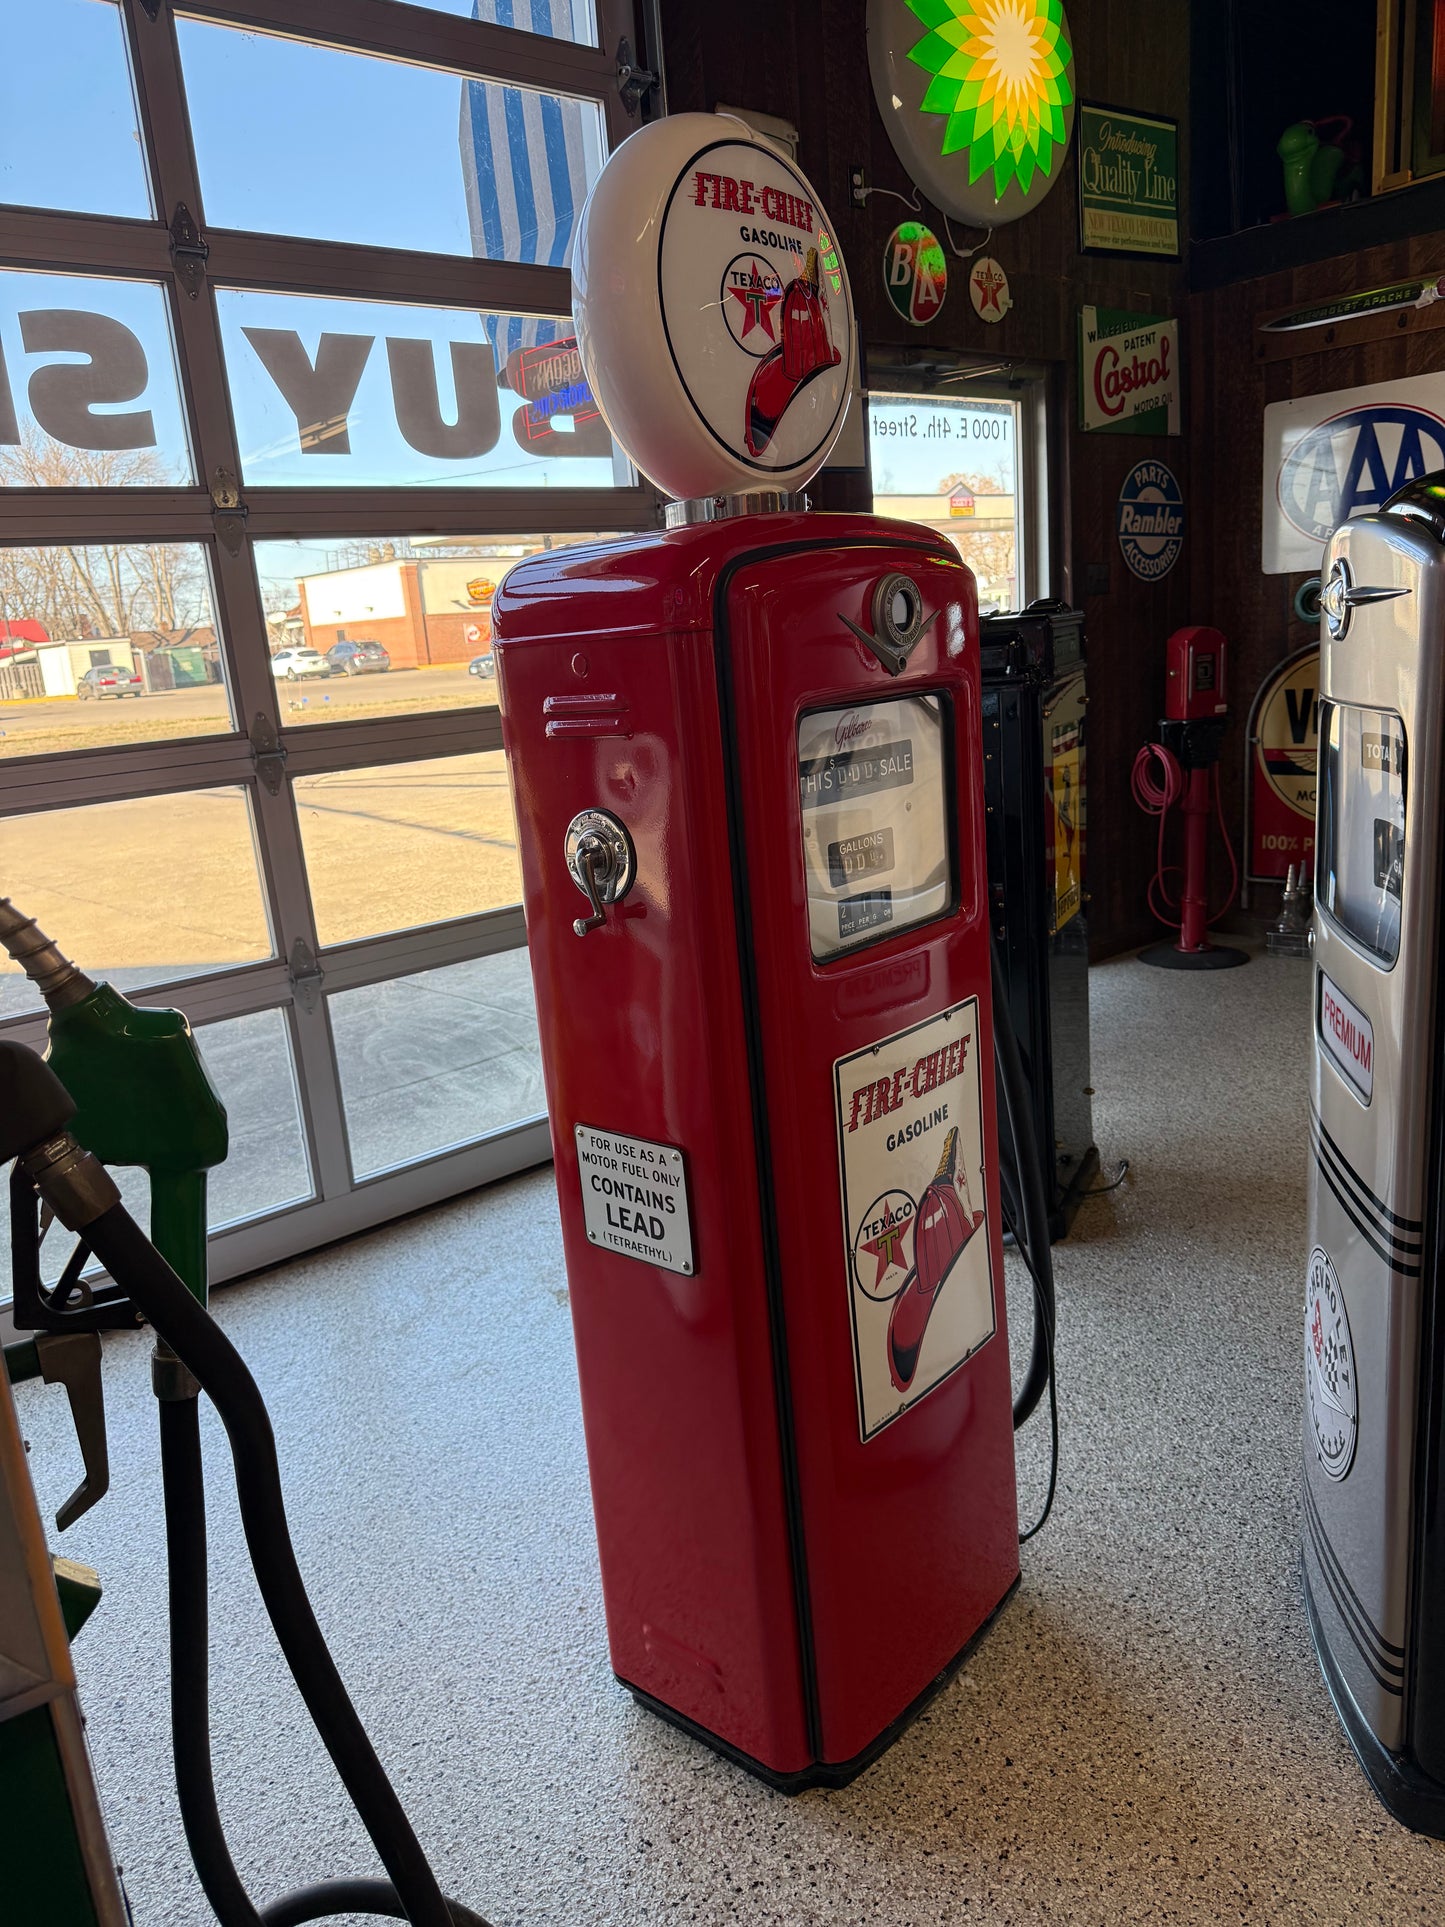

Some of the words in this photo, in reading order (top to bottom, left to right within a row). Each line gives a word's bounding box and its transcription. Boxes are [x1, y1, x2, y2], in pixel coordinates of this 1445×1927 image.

[1099, 121, 1157, 162] Introducing
[1083, 147, 1141, 204] Quality
[1144, 159, 1176, 201] Line
[689, 172, 813, 233] FIRE-CHIEF
[740, 226, 804, 255] GASOLINE
[1088, 212, 1104, 230] NEW
[1106, 214, 1134, 233] TEXACO
[1137, 217, 1174, 239] PRODUCTS
[731, 271, 780, 290] TEXACO
[889, 243, 914, 286] B
[918, 263, 940, 304] A
[976, 270, 1003, 282] TEXACO
[1088, 320, 1139, 343] WAKEFIELD
[1124, 332, 1157, 352] PATENT
[1094, 335, 1170, 416] Castrol
[1133, 396, 1159, 415] MOTOR
[1161, 392, 1173, 405] OIL
[1134, 466, 1169, 488] PARTS
[1120, 504, 1182, 534] Rambler
[1312, 525, 1334, 538] AP
[1125, 541, 1177, 575] ACCESSORIES
[1285, 688, 1319, 744] V
[800, 771, 833, 793] THIS
[880, 753, 912, 776] SALE
[1296, 790, 1317, 802] MO
[840, 833, 884, 855] GALLONS
[1261, 834, 1298, 851] 100%
[1303, 837, 1315, 851] P
[841, 921, 855, 931] PRICE
[858, 916, 869, 925] PER
[1325, 991, 1371, 1073] PREMIUM
[846, 1033, 971, 1133] FIRE-CHIEF
[887, 1104, 948, 1152] GASOLINE
[590, 1136, 610, 1151] FOR
[614, 1143, 636, 1158] USE
[640, 1149, 655, 1163] AS
[658, 1154, 667, 1166] A
[582, 1151, 618, 1170] MOTOR
[622, 1162, 649, 1179] FUEL
[653, 1171, 680, 1187] ONLY
[591, 1174, 676, 1214] CONTAINS
[606, 1202, 665, 1240] LEAD
[863, 1202, 912, 1240] TEXACO
[603, 1231, 673, 1263] (TETRAETHYL)
[1309, 1265, 1350, 1390] CHEVROLET
